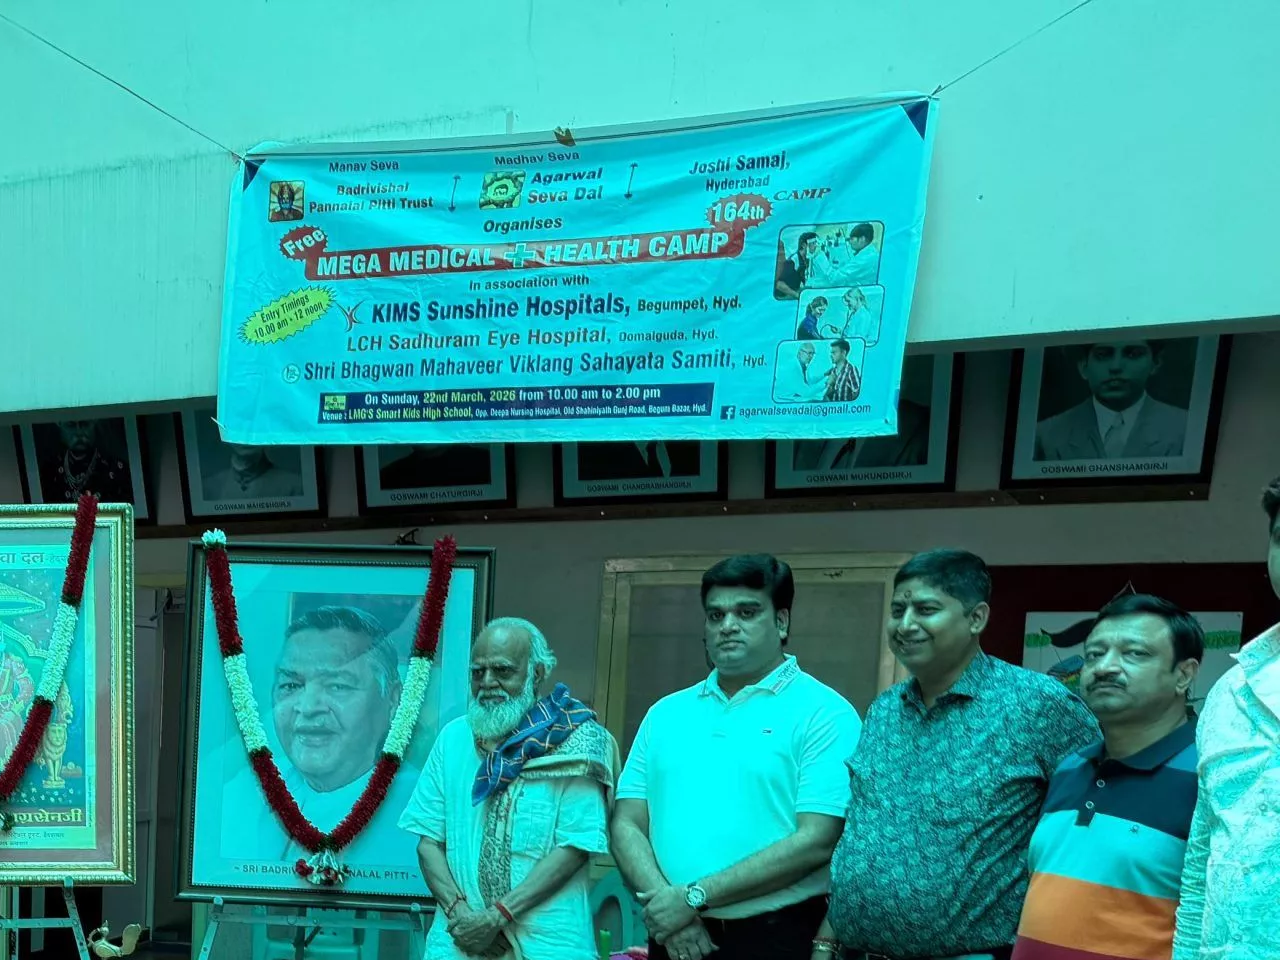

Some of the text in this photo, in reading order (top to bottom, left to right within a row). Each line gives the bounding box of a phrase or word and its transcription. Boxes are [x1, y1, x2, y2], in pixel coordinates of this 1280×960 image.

[328, 159, 400, 174] Manav Seva
[494, 151, 580, 166] Madhav Seva
[688, 150, 791, 175] Joshi Samaj,
[531, 167, 604, 186] Agarwal
[705, 175, 771, 194] Hyderabad
[336, 182, 409, 196] Badrivishal
[527, 185, 604, 204] Seva Dal
[309, 196, 434, 214] Pannalal Pitti Trust
[711, 187, 832, 223] 164th CAMP
[483, 216, 564, 235] Organises
[282, 229, 326, 256] Free
[316, 231, 729, 276] MEGA MEDICAL HEALTH CAMP
[485, 277, 558, 291] association
[562, 274, 590, 287] with
[260, 294, 310, 324] Entry Timings
[371, 292, 742, 323] KIMS Sunshine Hospitals, Begumpet, Hyd.
[254, 322, 276, 339] 10.00
[276, 318, 289, 330] am
[294, 308, 304, 321] 12
[305, 302, 324, 316] noon
[346, 326, 719, 352] LCH Sadhuram Eye Hospital, Domalguda, Hyd.
[303, 348, 768, 383] Shri Bhagwan Mahaveer Viklang Sahayata Samiti, Hyd.
[364, 387, 661, 406] On Sunday, 22nd March, 2026 from 10.00 am to 2.00 pm
[322, 411, 343, 421] Venue
[348, 408, 374, 419] LMG'S
[376, 408, 401, 419] Smart
[403, 407, 421, 419] Kids
[423, 407, 441, 420] High
[443, 406, 474, 418] School,
[490, 408, 509, 417] Deepa
[511, 407, 534, 417] Nursing
[563, 406, 575, 415] Old
[740, 404, 871, 418] agarwalsevadal@gmail.com
[1041, 464, 1086, 474] GOSWAMI
[390, 492, 428, 502] GOSWAMI
[21, 551, 45, 565] दल
[242, 864, 258, 873] SRI
[261, 865, 297, 875] BADRI
[384, 870, 409, 881] PITTI
